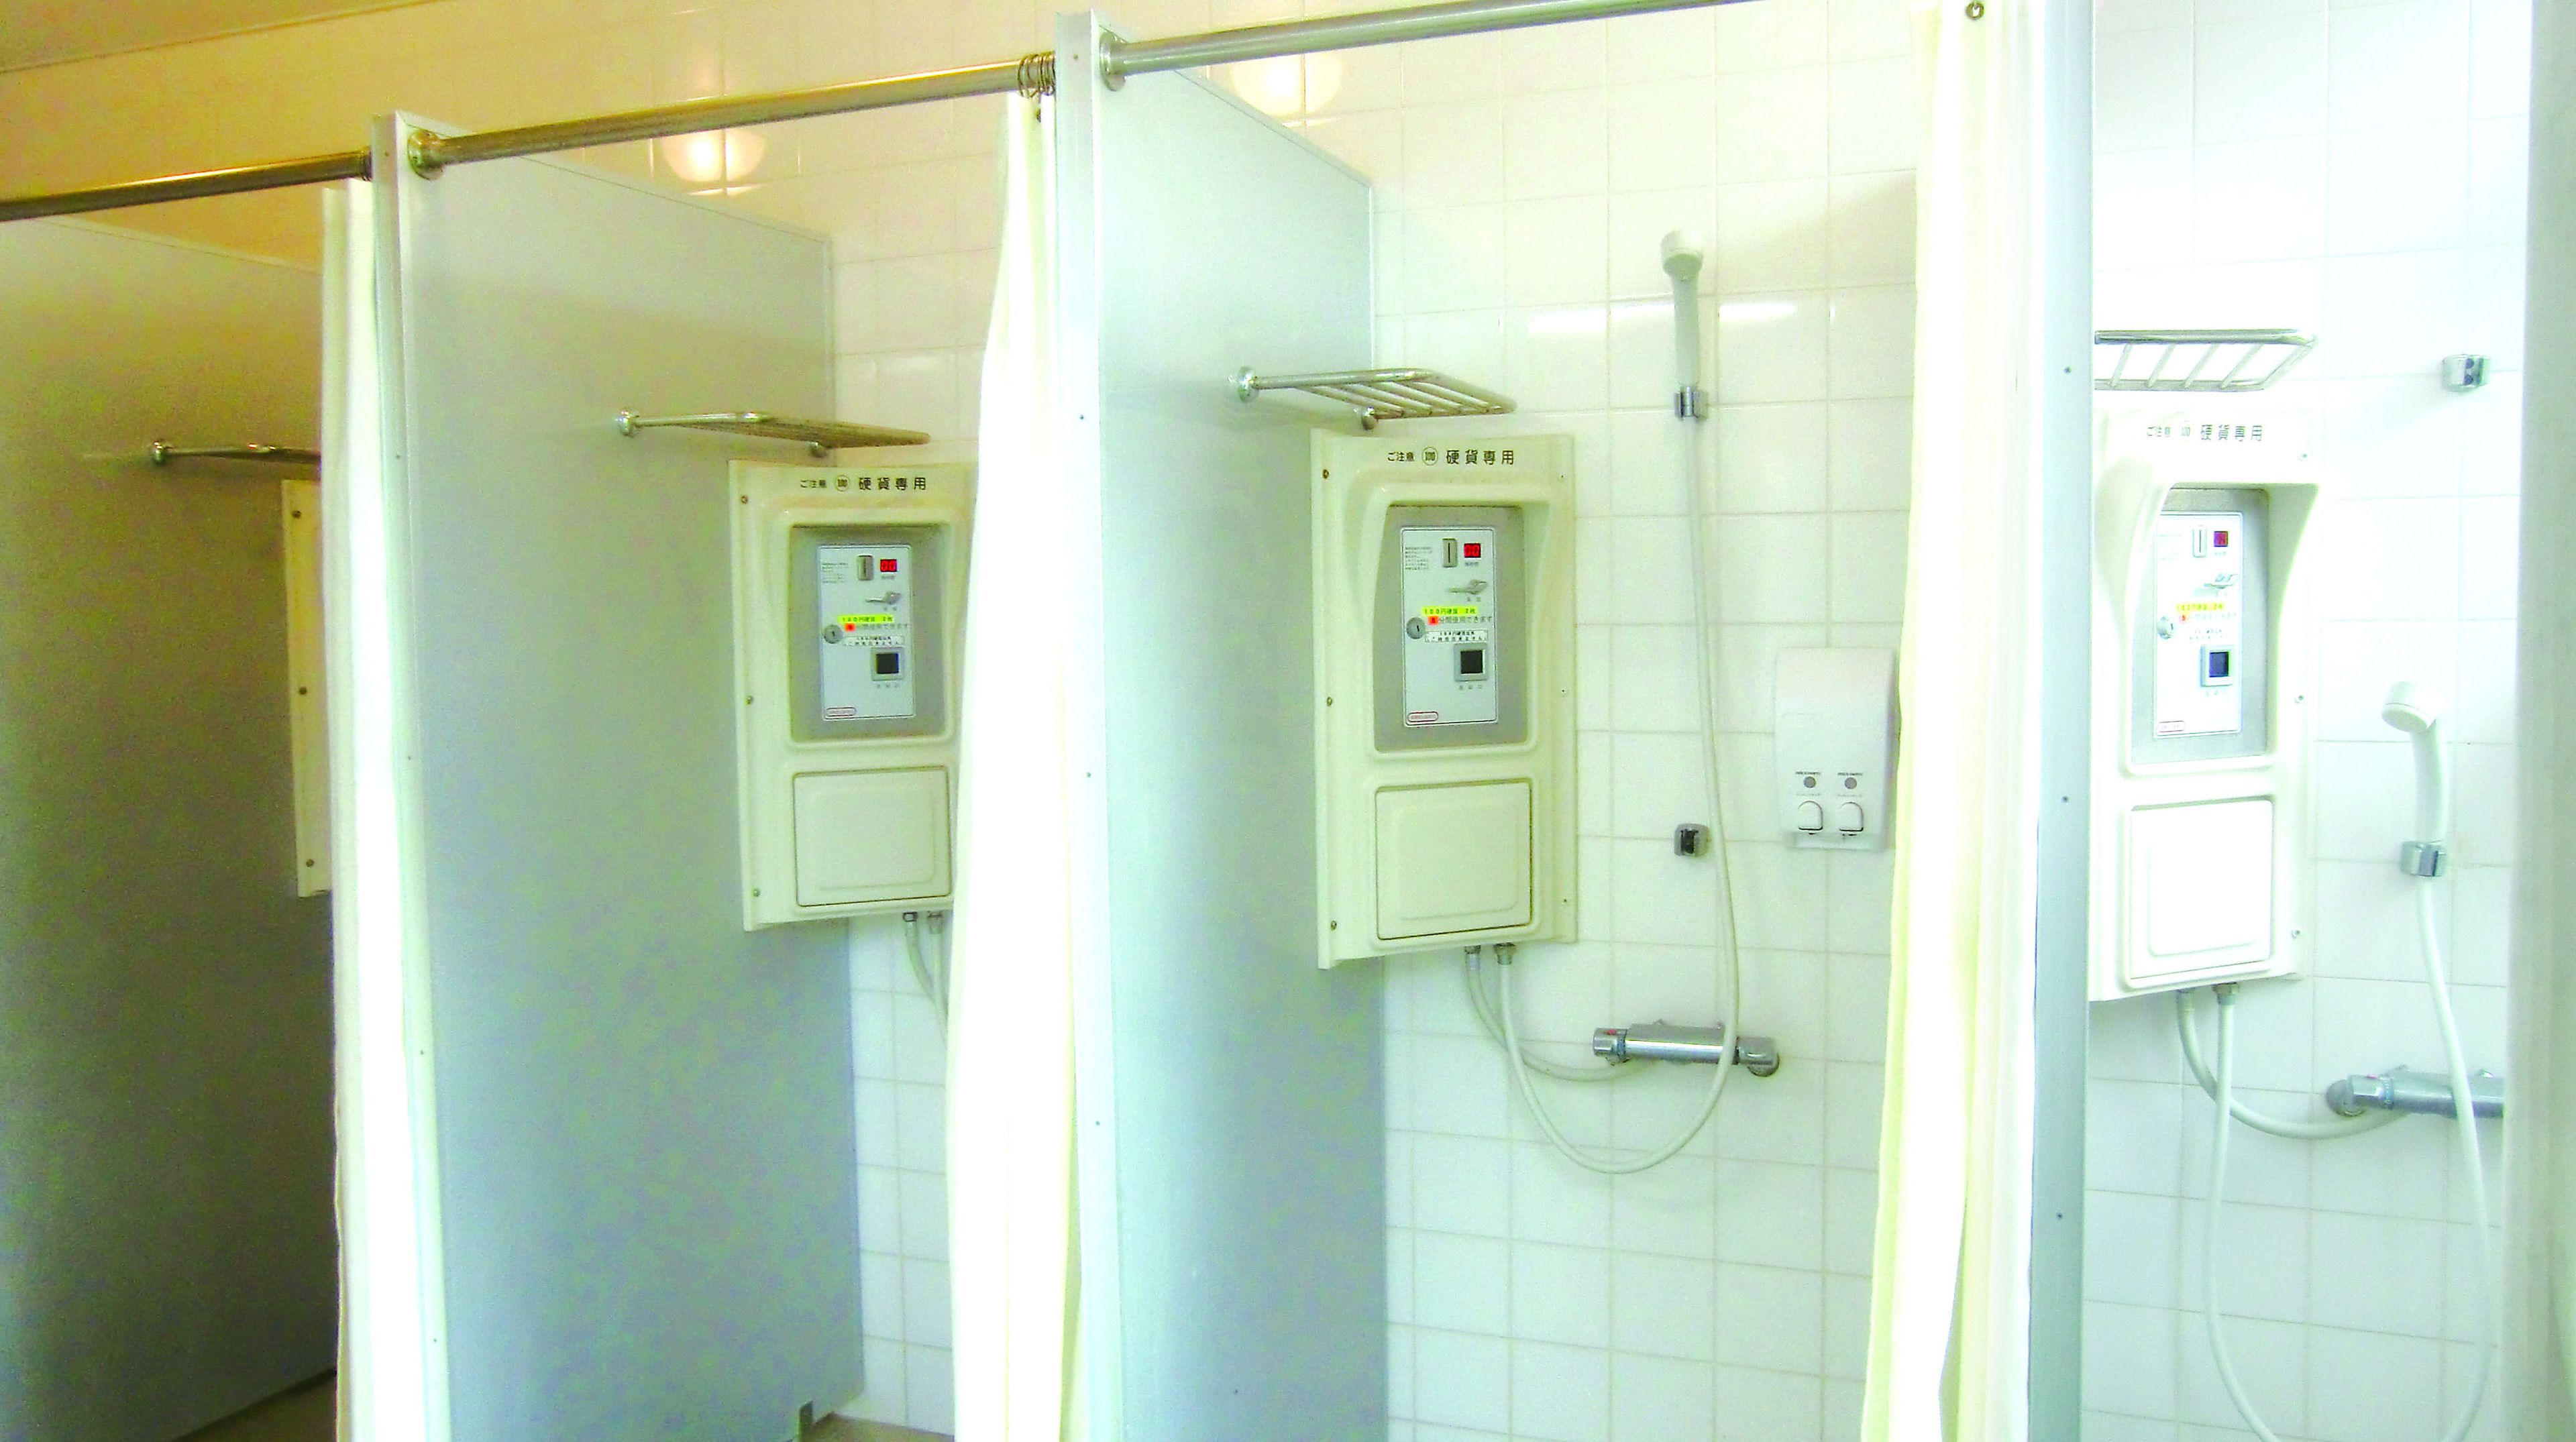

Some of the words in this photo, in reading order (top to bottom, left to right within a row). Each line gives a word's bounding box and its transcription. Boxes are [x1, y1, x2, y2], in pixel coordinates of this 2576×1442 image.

[2200, 425, 2262, 441] 硬貨専用
[1446, 449, 1514, 465] 硬貨専用
[859, 477, 926, 490] 硬貨専用
